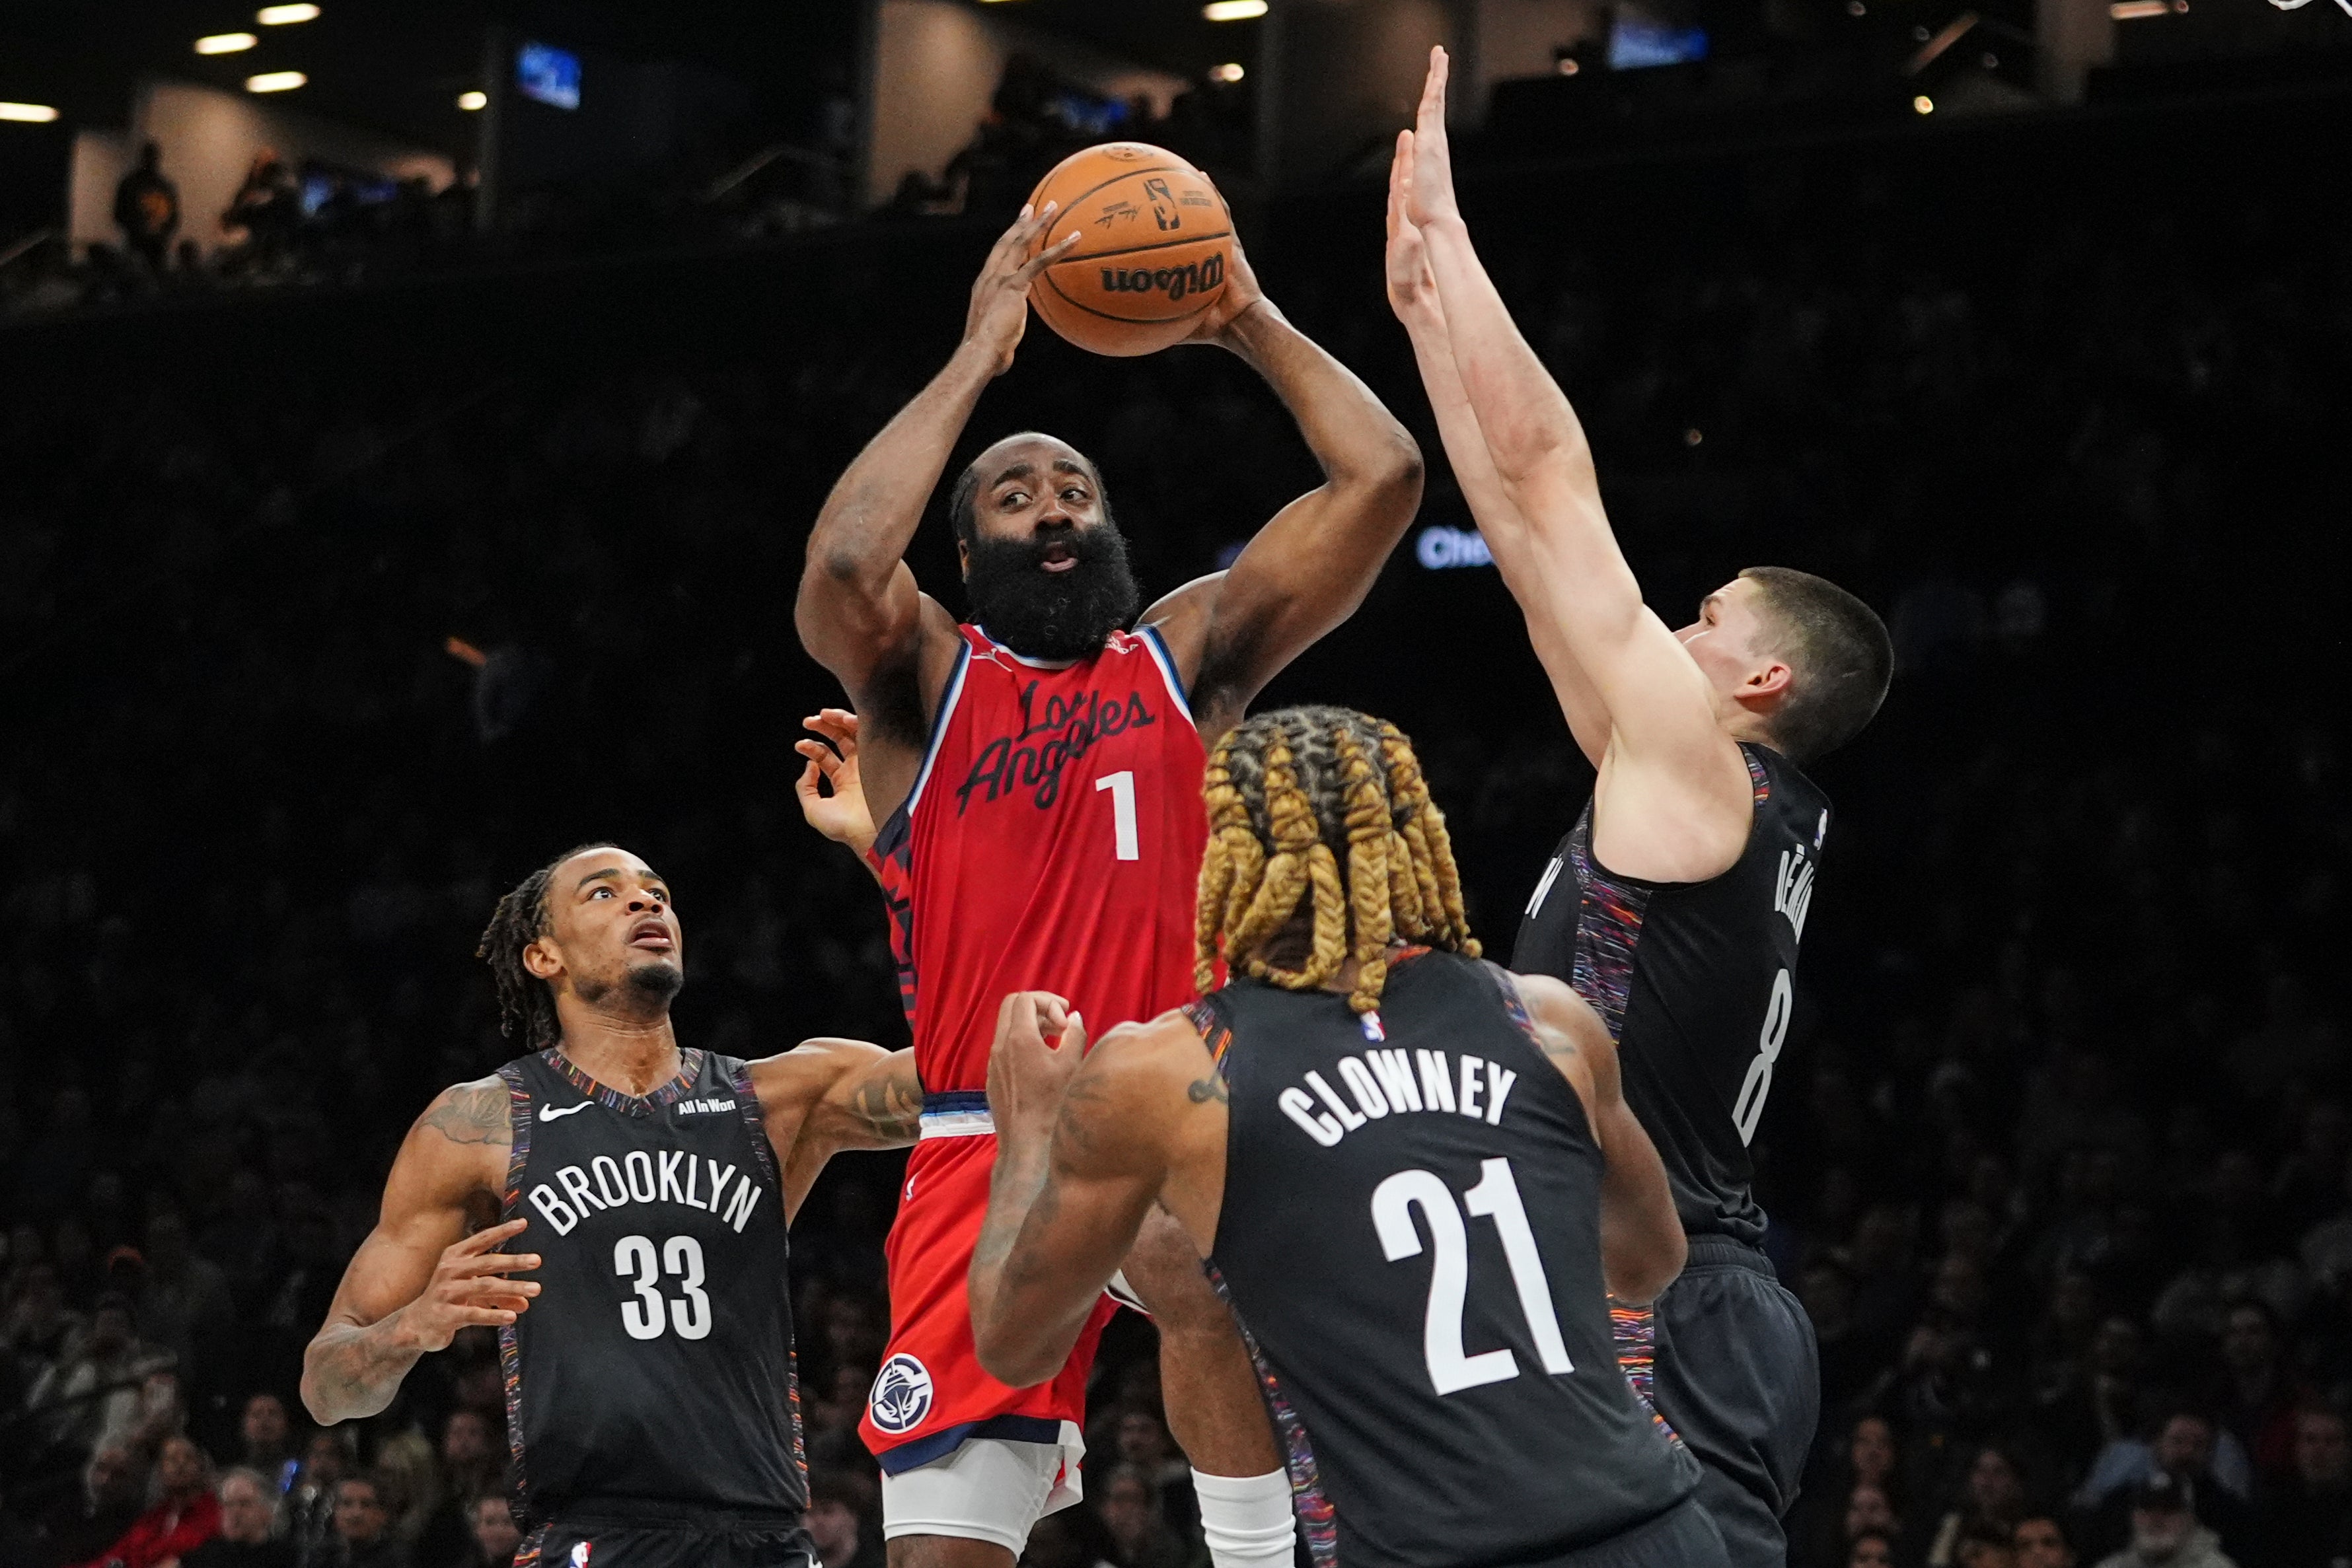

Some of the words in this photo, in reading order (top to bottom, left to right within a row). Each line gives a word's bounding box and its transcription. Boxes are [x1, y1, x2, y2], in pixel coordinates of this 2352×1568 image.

[1100, 250, 1224, 301] Wilson
[955, 690, 1155, 818] Angeles
[1095, 771, 1138, 860] 1
[1279, 1049, 1516, 1147] CLOWNEY
[1732, 969, 1792, 1147] 8
[529, 1151, 762, 1236] BROOKLYN
[614, 1235, 712, 1340] 33
[1372, 1158, 1574, 1396] 21
